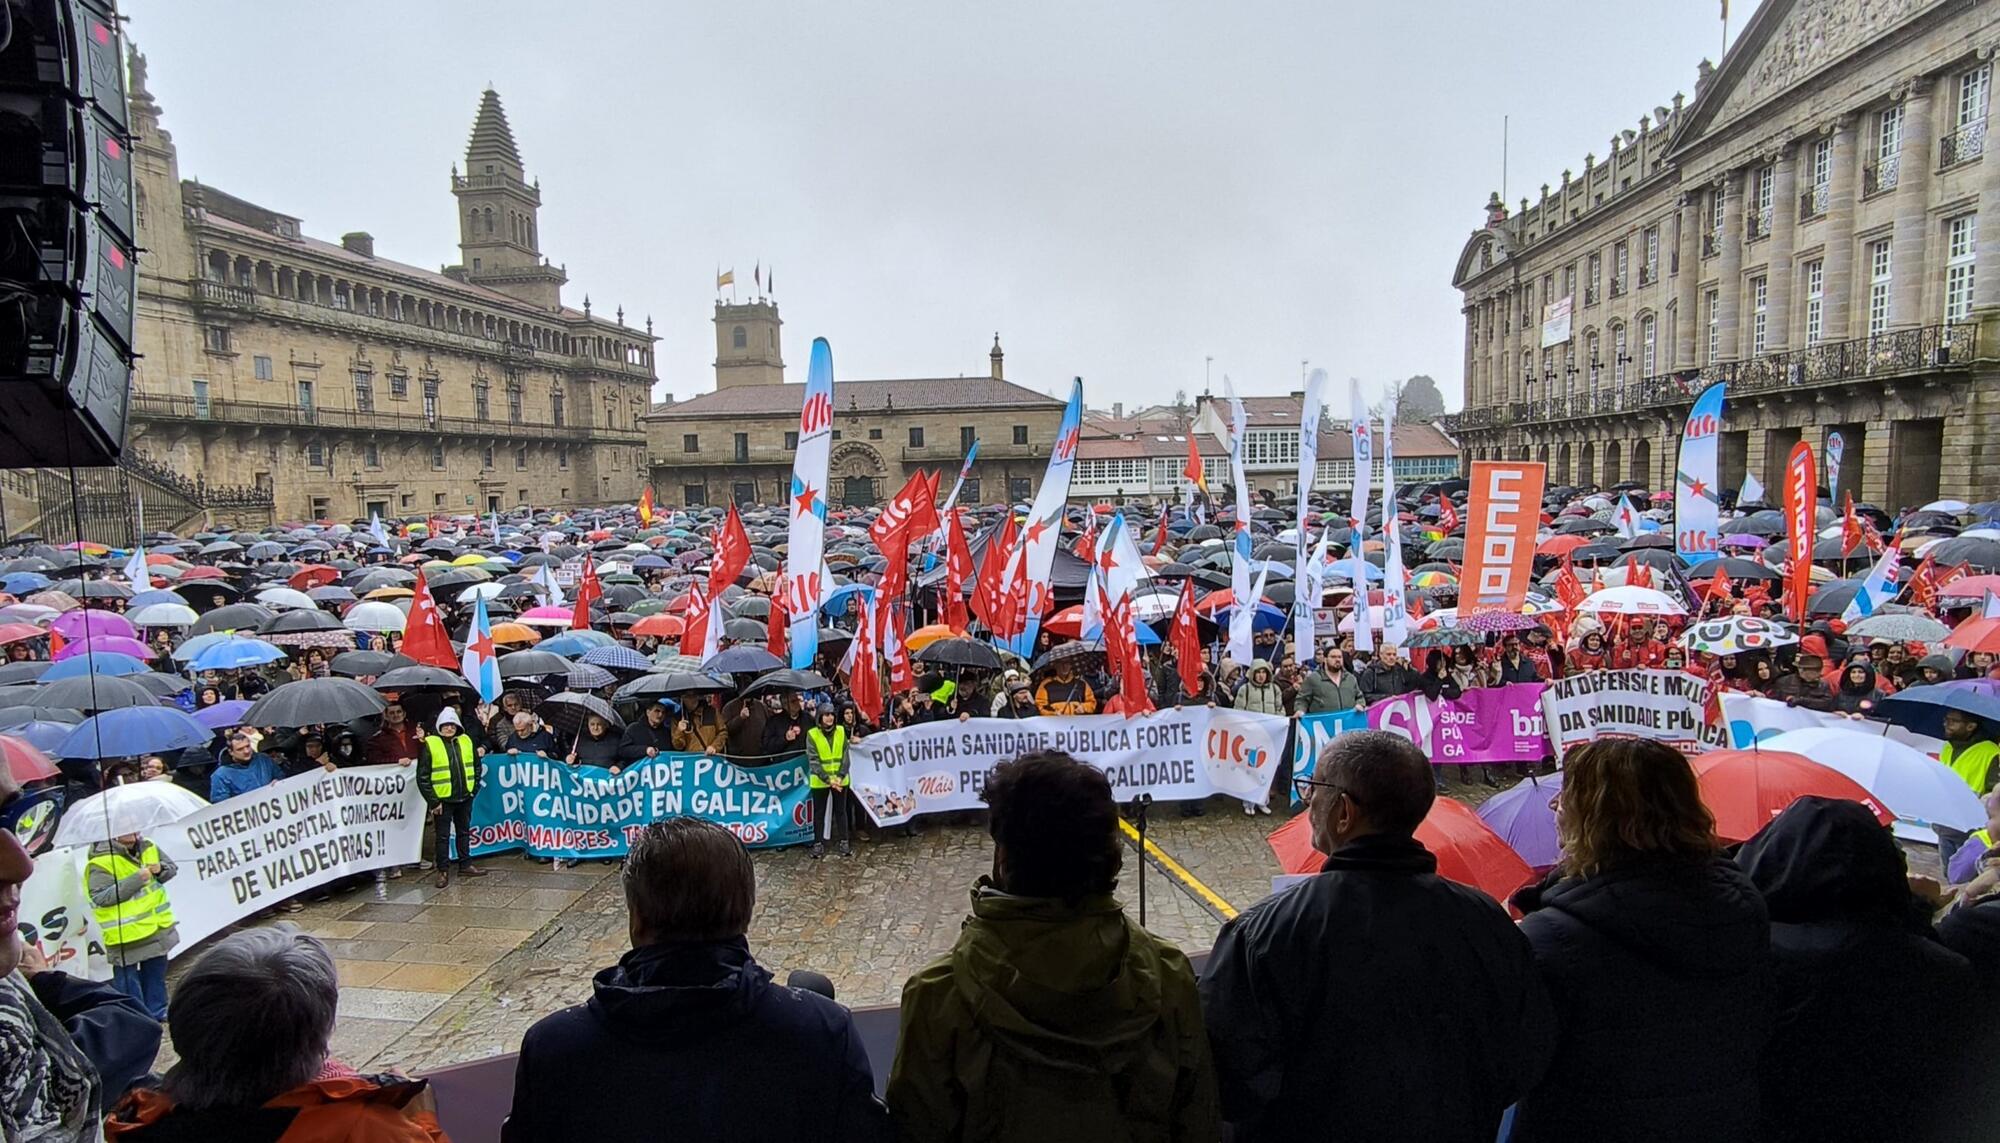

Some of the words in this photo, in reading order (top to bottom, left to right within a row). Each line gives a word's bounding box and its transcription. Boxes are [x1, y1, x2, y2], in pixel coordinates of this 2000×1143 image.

[1478, 469, 1523, 594] CCOO
[1555, 679, 1575, 700] NA
[1651, 676, 1658, 695] E
[1560, 711, 1586, 732] DA
[872, 743, 906, 771] POR
[908, 736, 957, 762] UNHA
[961, 732, 1049, 757] SANIDADE
[1056, 725, 1131, 753] PÚBLICA
[1136, 722, 1192, 749] FORTE
[498, 761, 563, 794] UNHA
[570, 759, 684, 801] SANIDADE
[918, 776, 954, 795] Máis
[1105, 759, 1195, 788] CALIDADE
[187, 797, 283, 849] QUEREMOS
[286, 788, 309, 815] UN
[312, 774, 405, 805] NEUMOLOGO
[502, 789, 525, 815] DE
[532, 791, 644, 825] CALIDADE
[652, 789, 682, 817] EN
[691, 788, 783, 817] GALIZA
[197, 847, 240, 880] PARA
[241, 839, 262, 862] EL
[264, 810, 337, 854] HOSPITAL
[341, 801, 405, 827] COMARCAL
[232, 869, 262, 905] DE
[262, 831, 373, 890] VALDEORRAS
